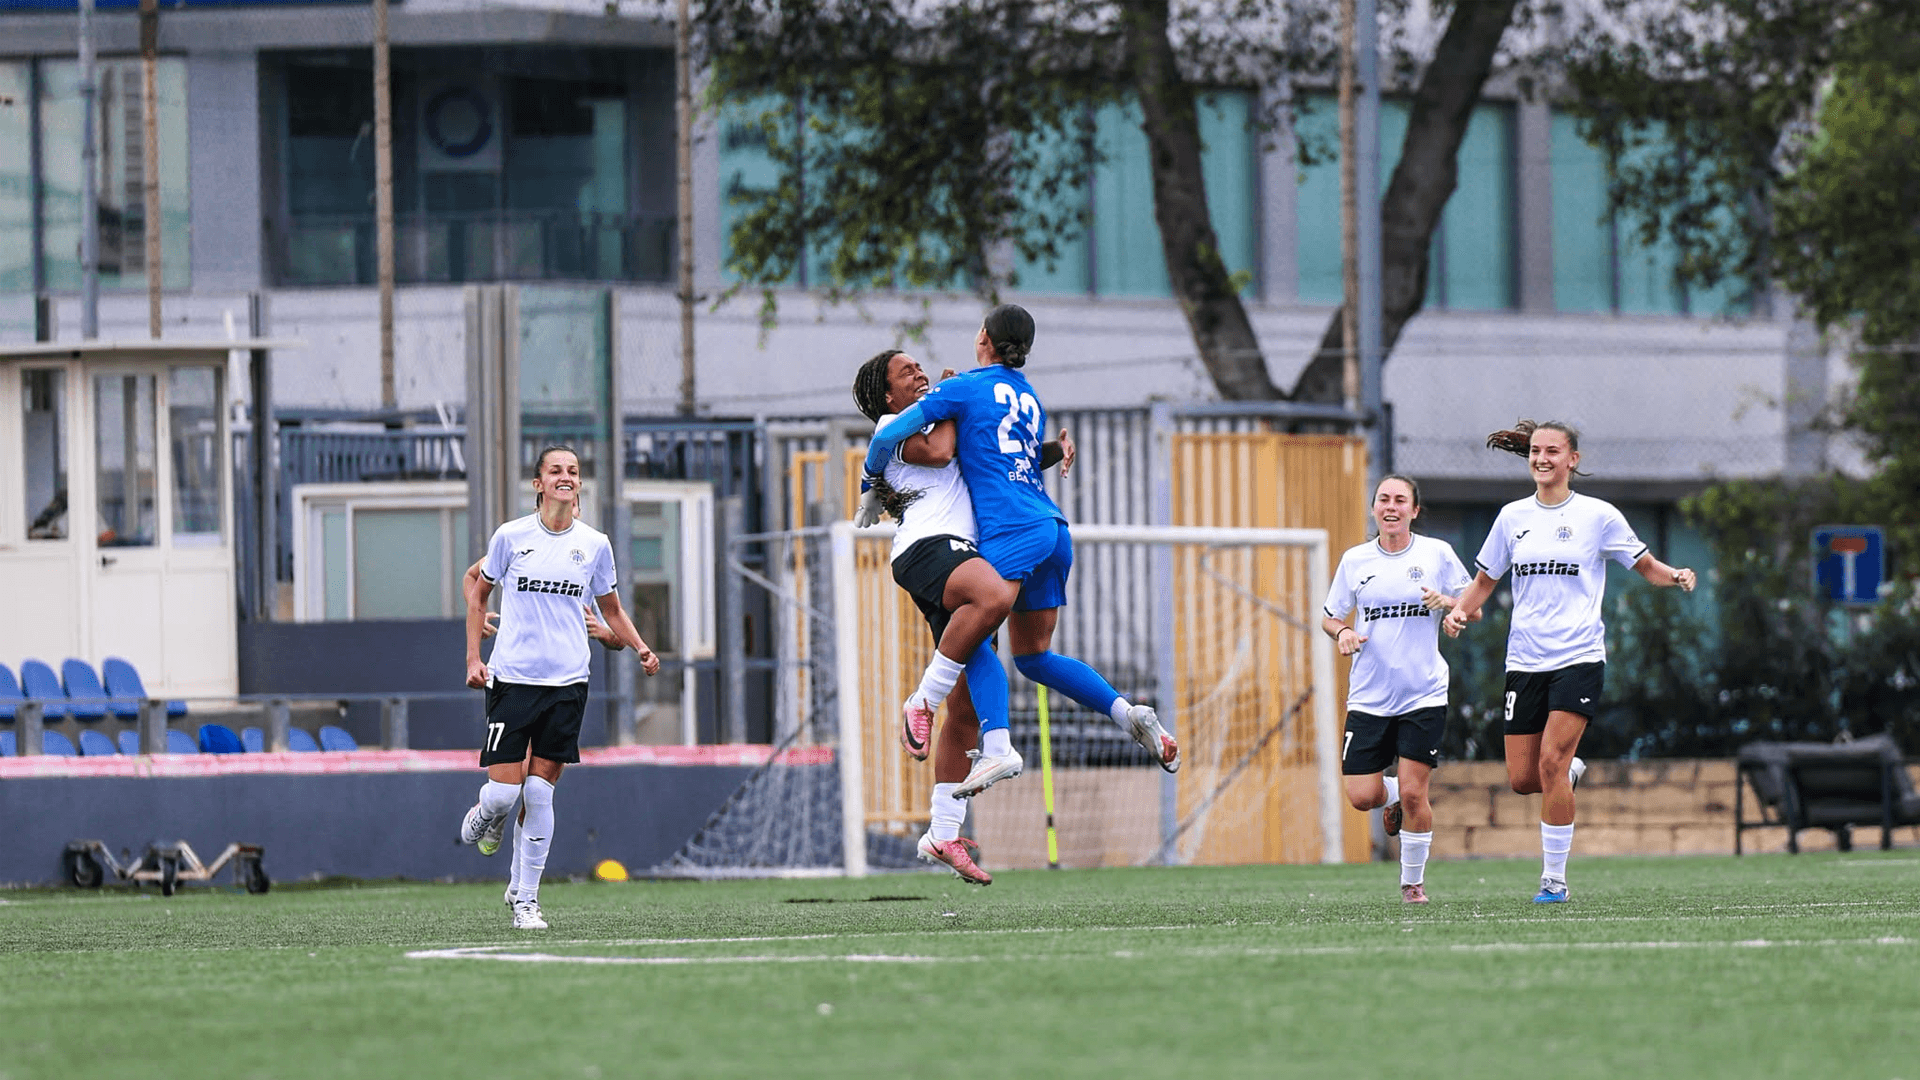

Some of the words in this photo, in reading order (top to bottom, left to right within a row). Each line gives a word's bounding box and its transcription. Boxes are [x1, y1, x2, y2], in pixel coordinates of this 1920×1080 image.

[993, 382, 1040, 459] 23
[1514, 559, 1580, 577] Bezzina
[486, 722, 505, 752] 17
